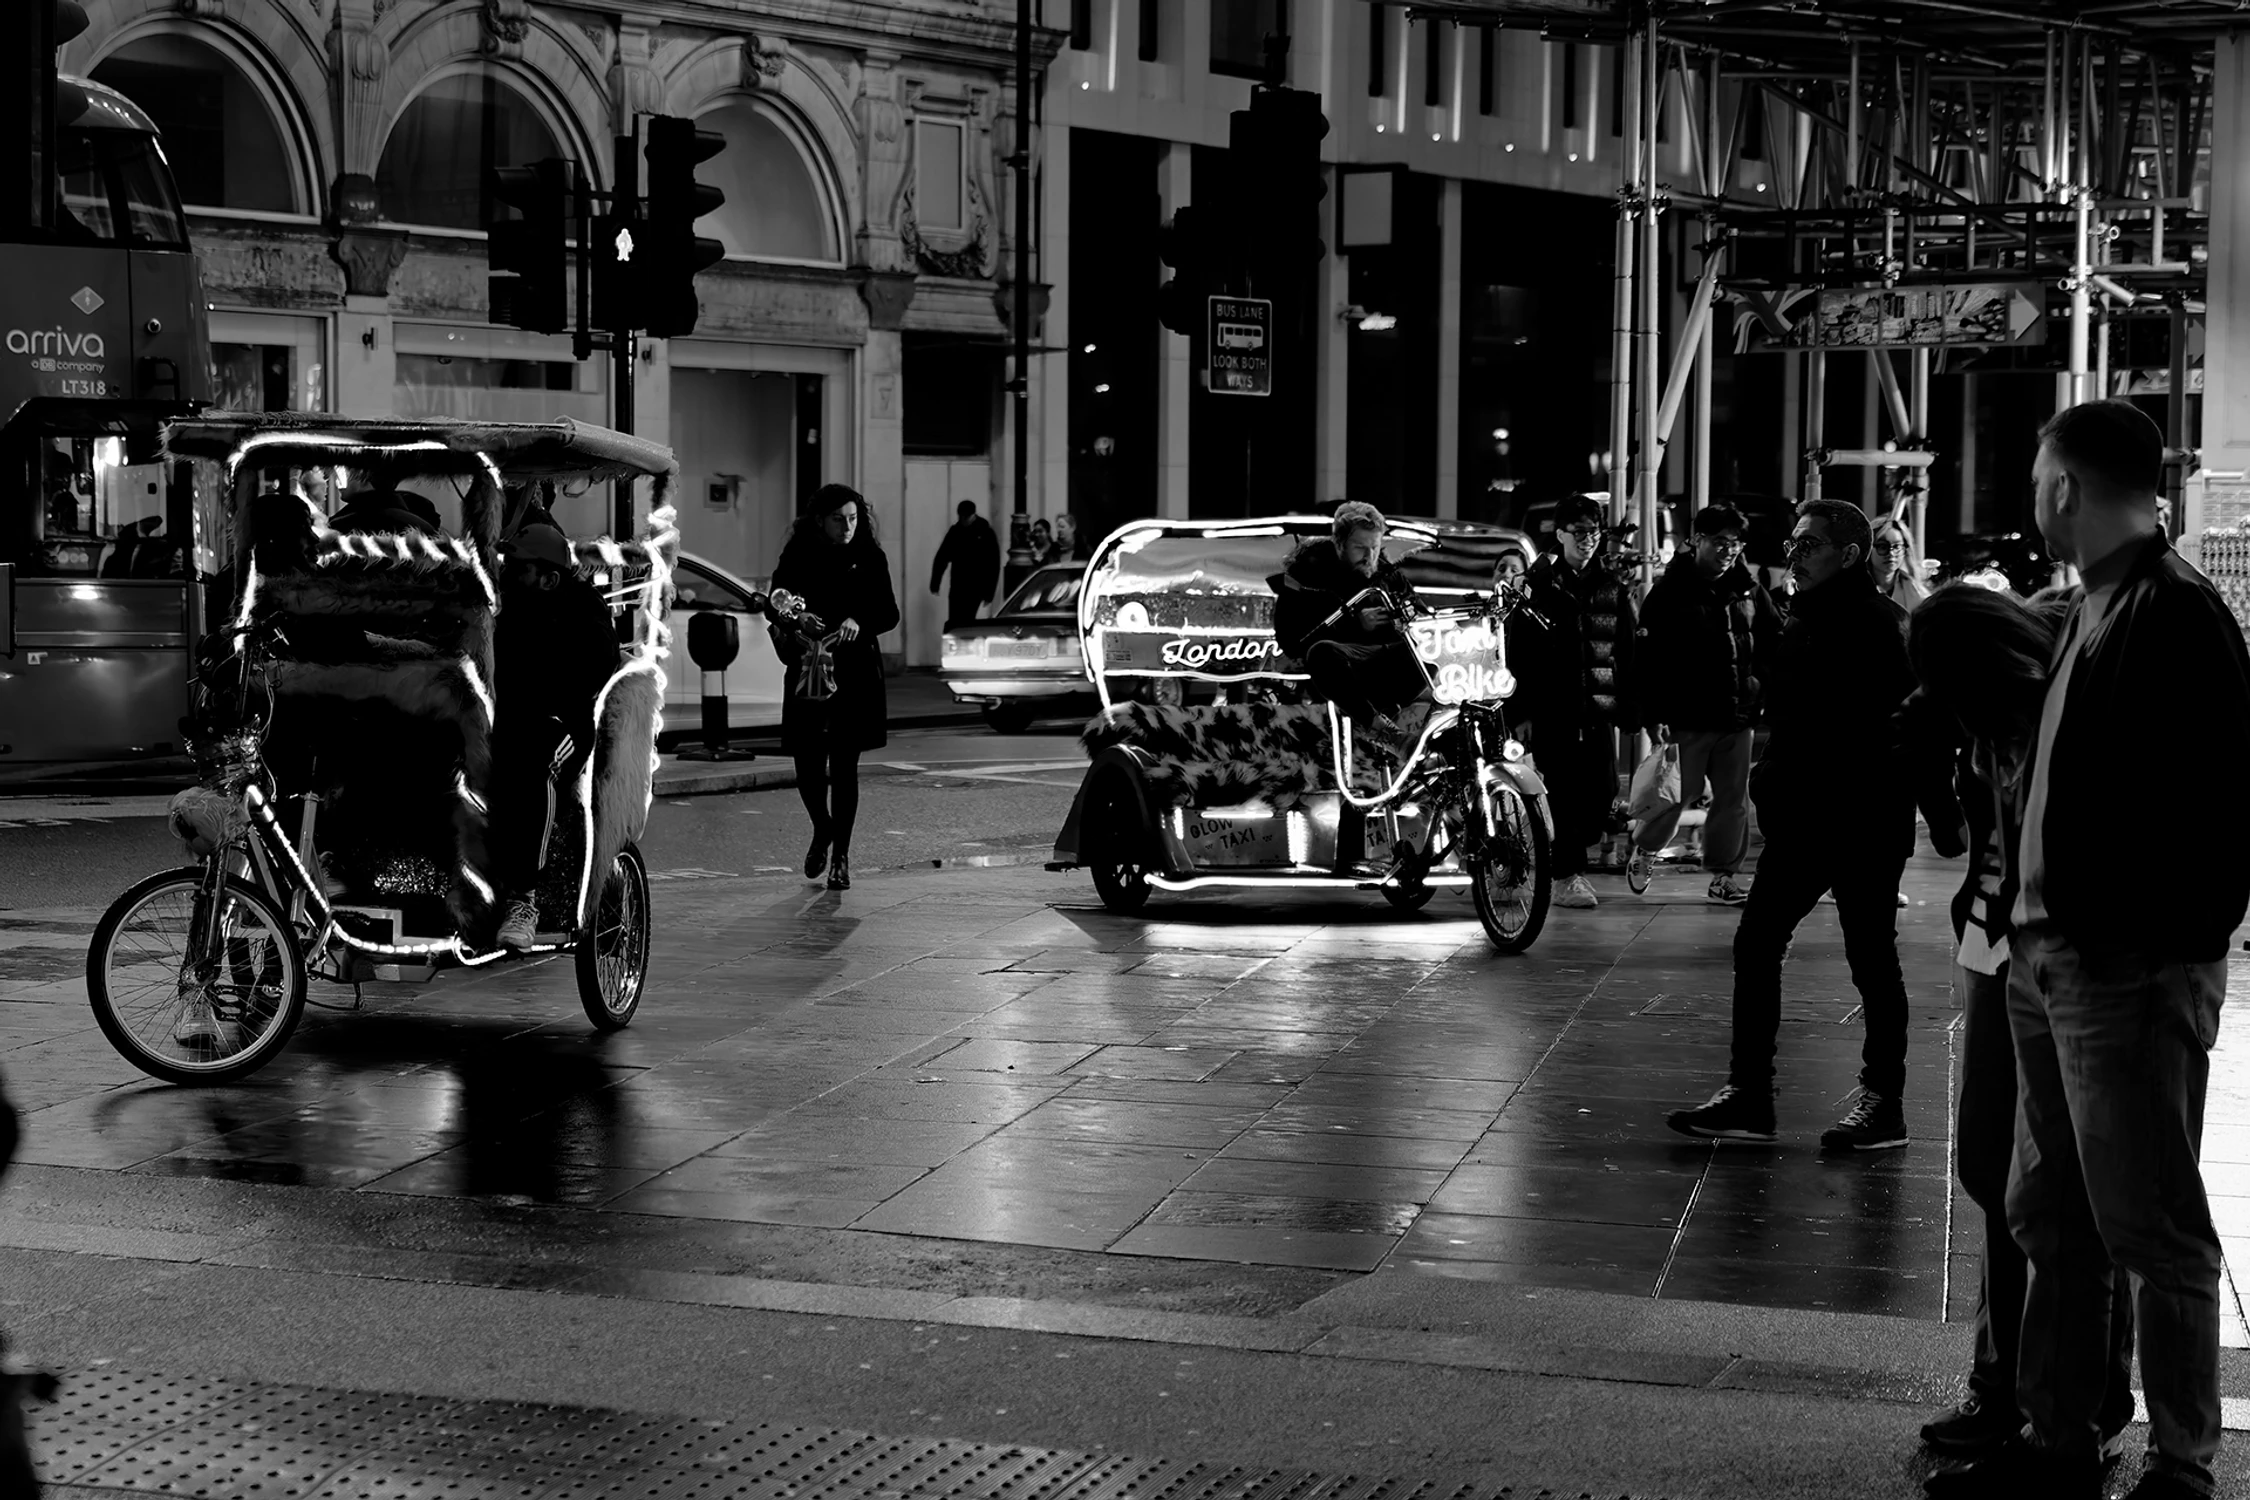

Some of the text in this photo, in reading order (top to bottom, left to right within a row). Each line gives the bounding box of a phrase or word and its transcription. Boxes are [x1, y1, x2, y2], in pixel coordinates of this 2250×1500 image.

[1216, 304, 1264, 320] BUS LANE
[6, 324, 105, 358] arriva
[57, 361, 105, 374] company
[1213, 354, 1268, 370] LOOK BOTH
[62, 379, 106, 396] LT318
[1227, 374, 1254, 388] WAYS
[1161, 638, 1284, 668] London
[1220, 827, 1256, 849] TAXI
